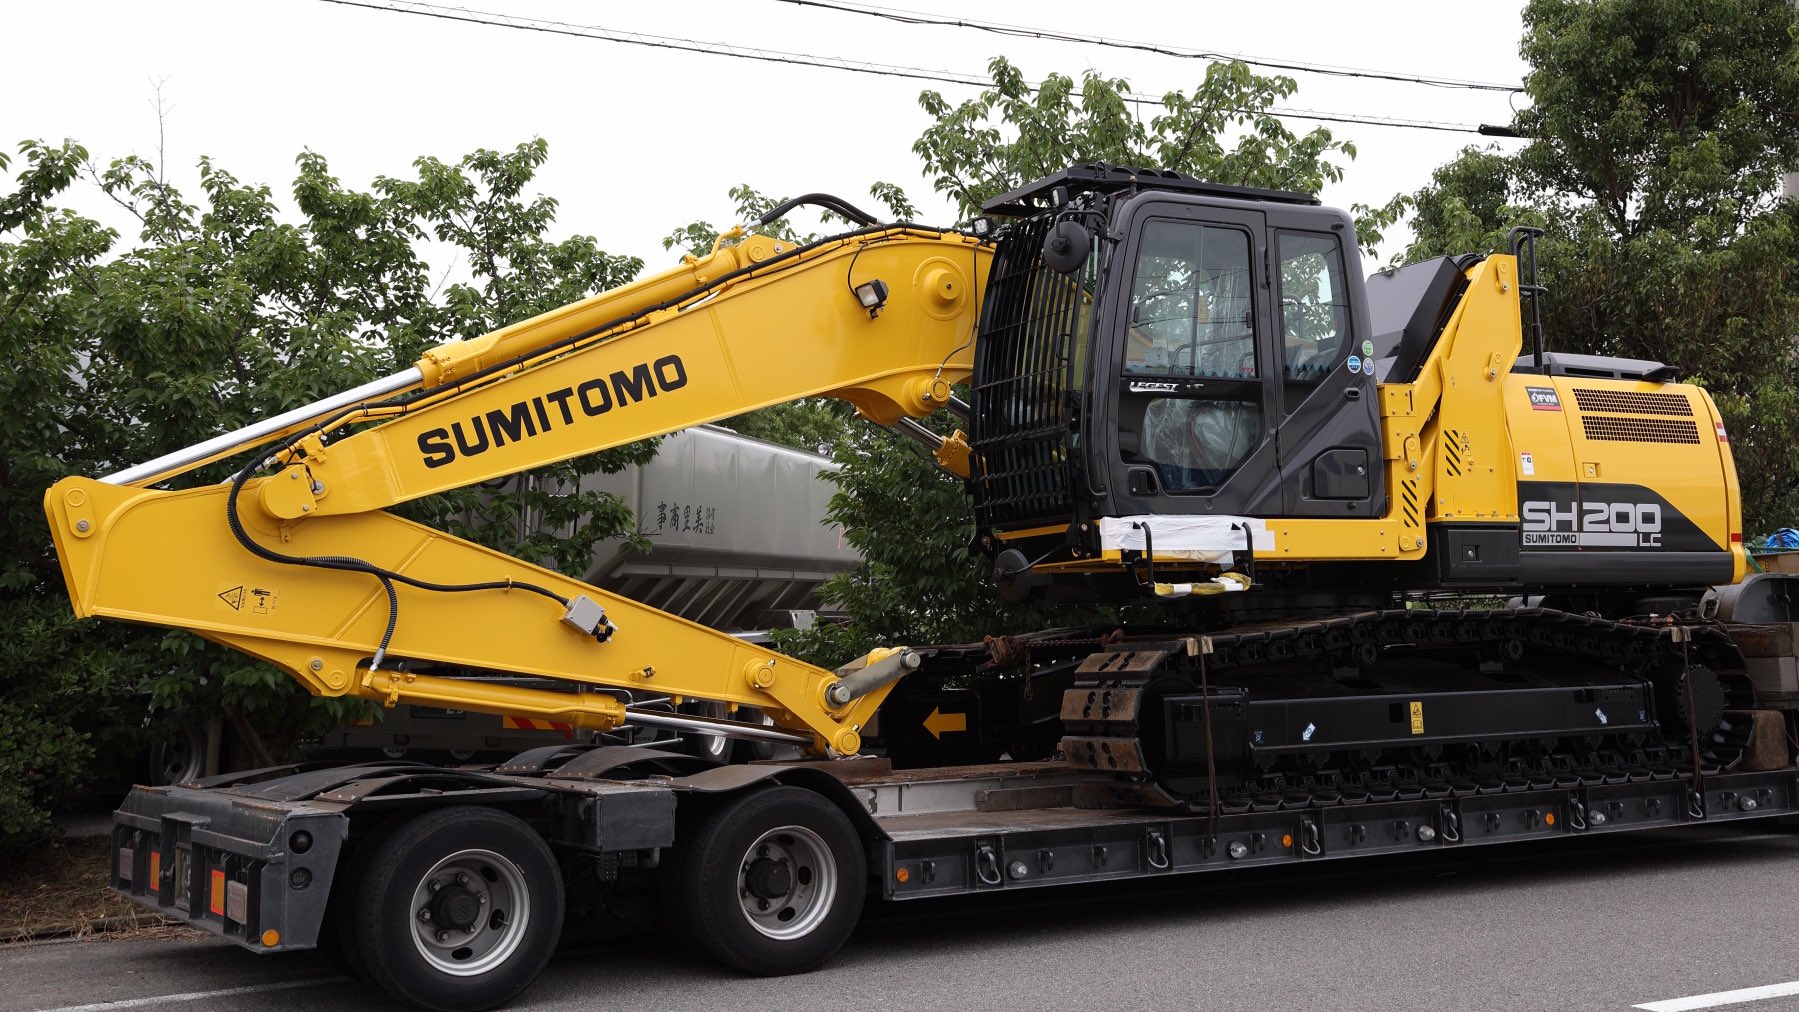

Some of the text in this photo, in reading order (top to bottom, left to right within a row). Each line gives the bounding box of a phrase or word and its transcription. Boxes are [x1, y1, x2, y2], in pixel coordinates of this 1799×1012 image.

[1129, 382, 1179, 392] LEGEST
[1539, 394, 1558, 403] FVM
[417, 354, 688, 468] SUMITOMO
[1523, 501, 1661, 532] SH200
[1525, 534, 1577, 544] SUMITOMO
[1639, 533, 1662, 547] LC
